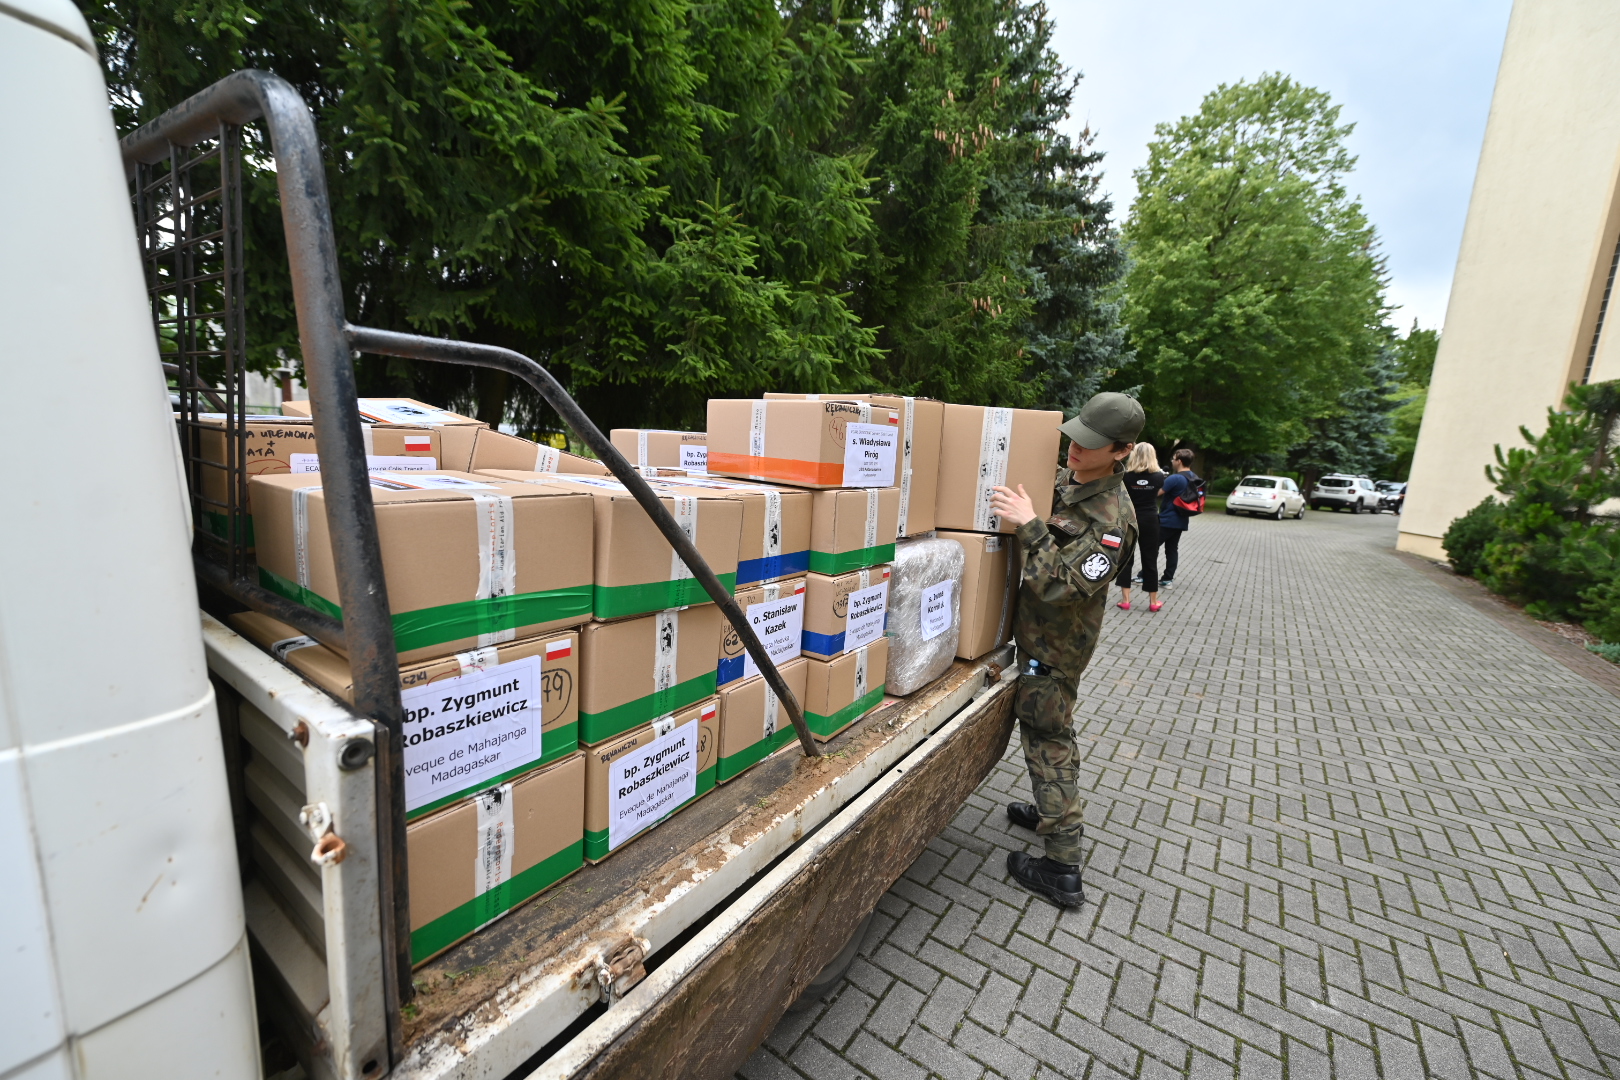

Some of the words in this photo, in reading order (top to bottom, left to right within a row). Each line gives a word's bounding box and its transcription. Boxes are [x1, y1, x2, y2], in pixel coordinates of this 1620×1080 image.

[246, 448, 275, 457] ATA
[696, 451, 707, 459] Zyg
[762, 603, 798, 622] Stanisław
[764, 619, 787, 636] Kazek
[402, 708, 436, 724] bp.
[441, 678, 520, 713] Zygmunt
[402, 698, 528, 749] Robaszkiewicz
[405, 756, 446, 777] veque
[448, 749, 464, 762] de
[468, 726, 528, 756] Mahajanga
[430, 751, 502, 785] Madagaskar
[624, 766, 641, 779] bp.
[643, 736, 686, 769] Zygmunt
[618, 751, 690, 800] Robaszkiewicz
[619, 797, 646, 820] Eveque
[646, 792, 655, 803] de
[656, 771, 689, 796] Mahajanga
[636, 792, 675, 821] Madagaskar
